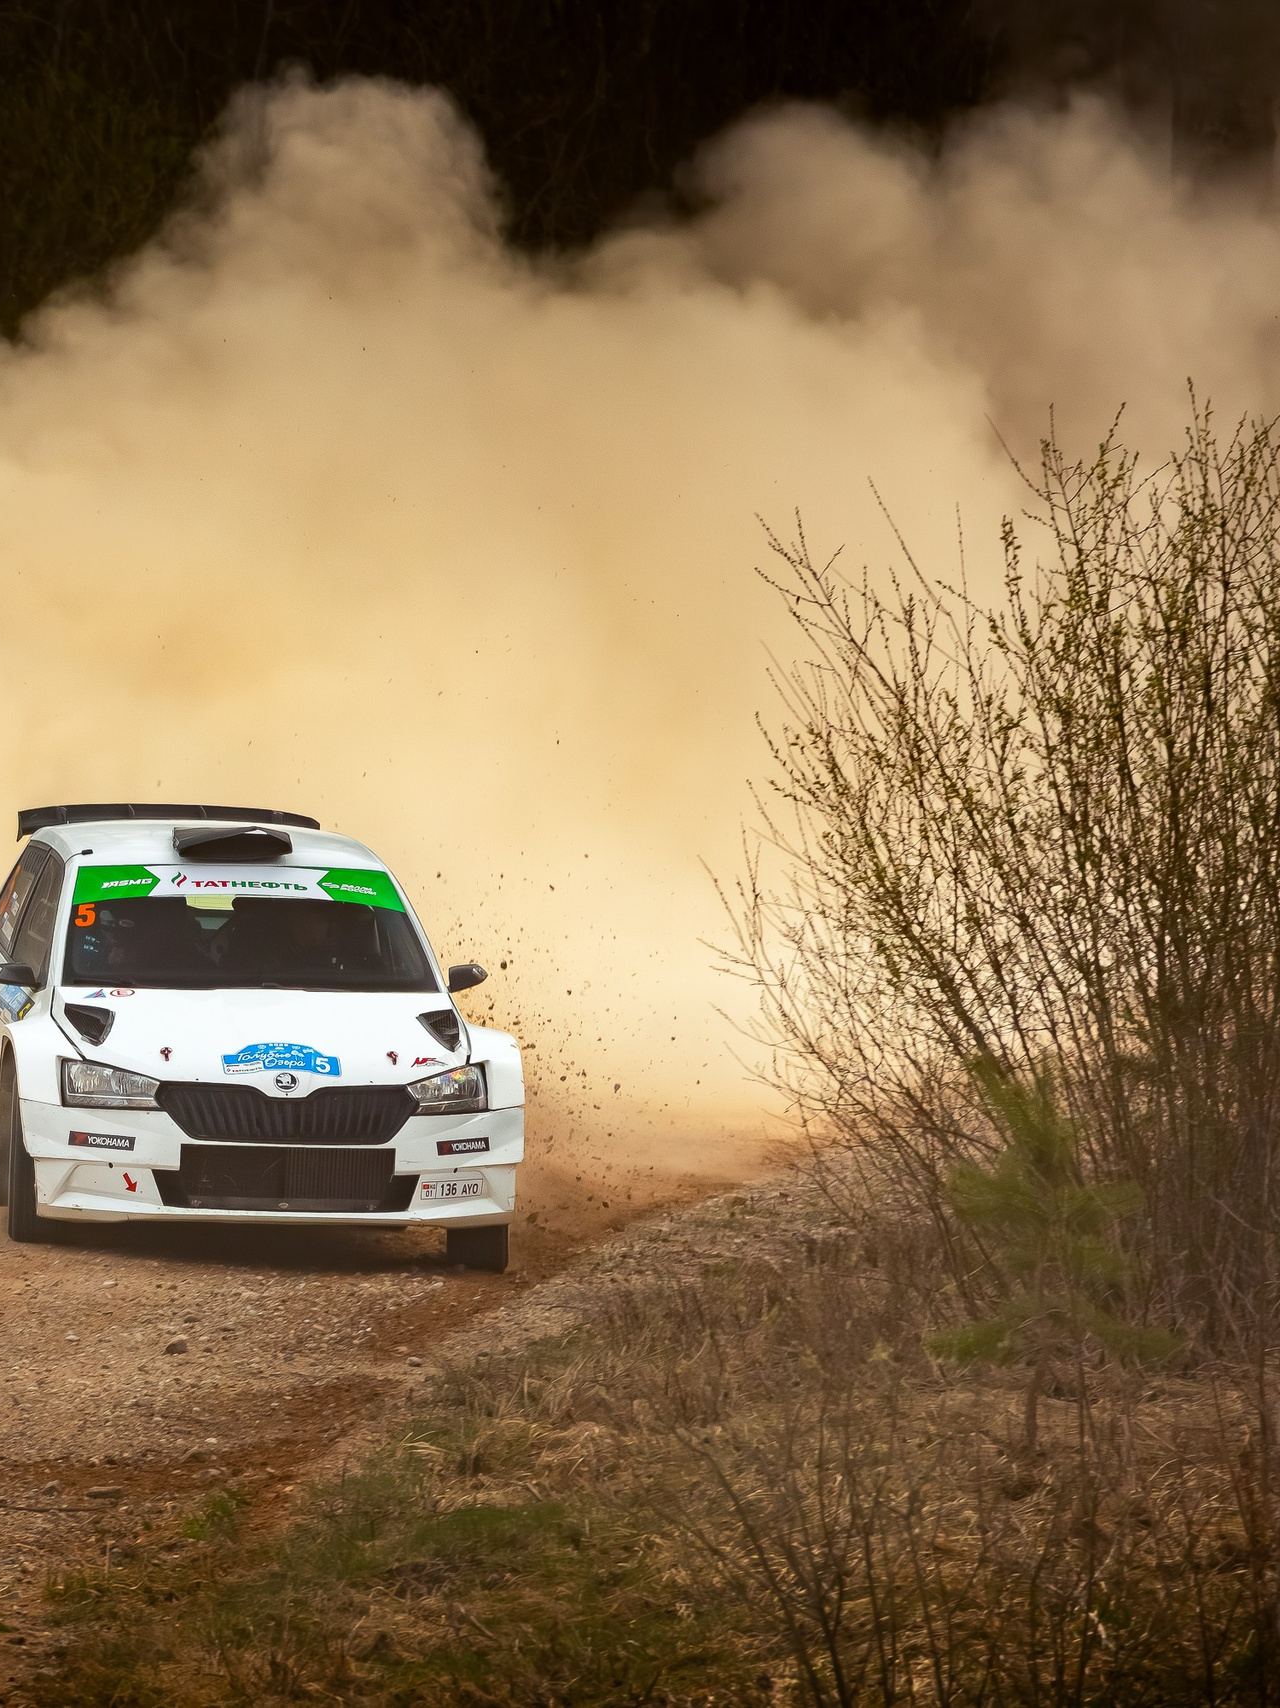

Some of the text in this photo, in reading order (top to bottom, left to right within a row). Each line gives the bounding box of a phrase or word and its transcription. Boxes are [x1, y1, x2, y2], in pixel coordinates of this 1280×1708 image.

[191, 880, 308, 891] ТАТНЕФТЬ
[74, 903, 96, 928] 5
[237, 1051, 292, 1062] Голубые
[264, 1057, 307, 1069] Озера
[315, 1056, 331, 1073] 5
[87, 1136, 130, 1148] YOKOHAMA
[451, 1140, 487, 1152] YOKOHAMA
[440, 1182, 458, 1197] 136
